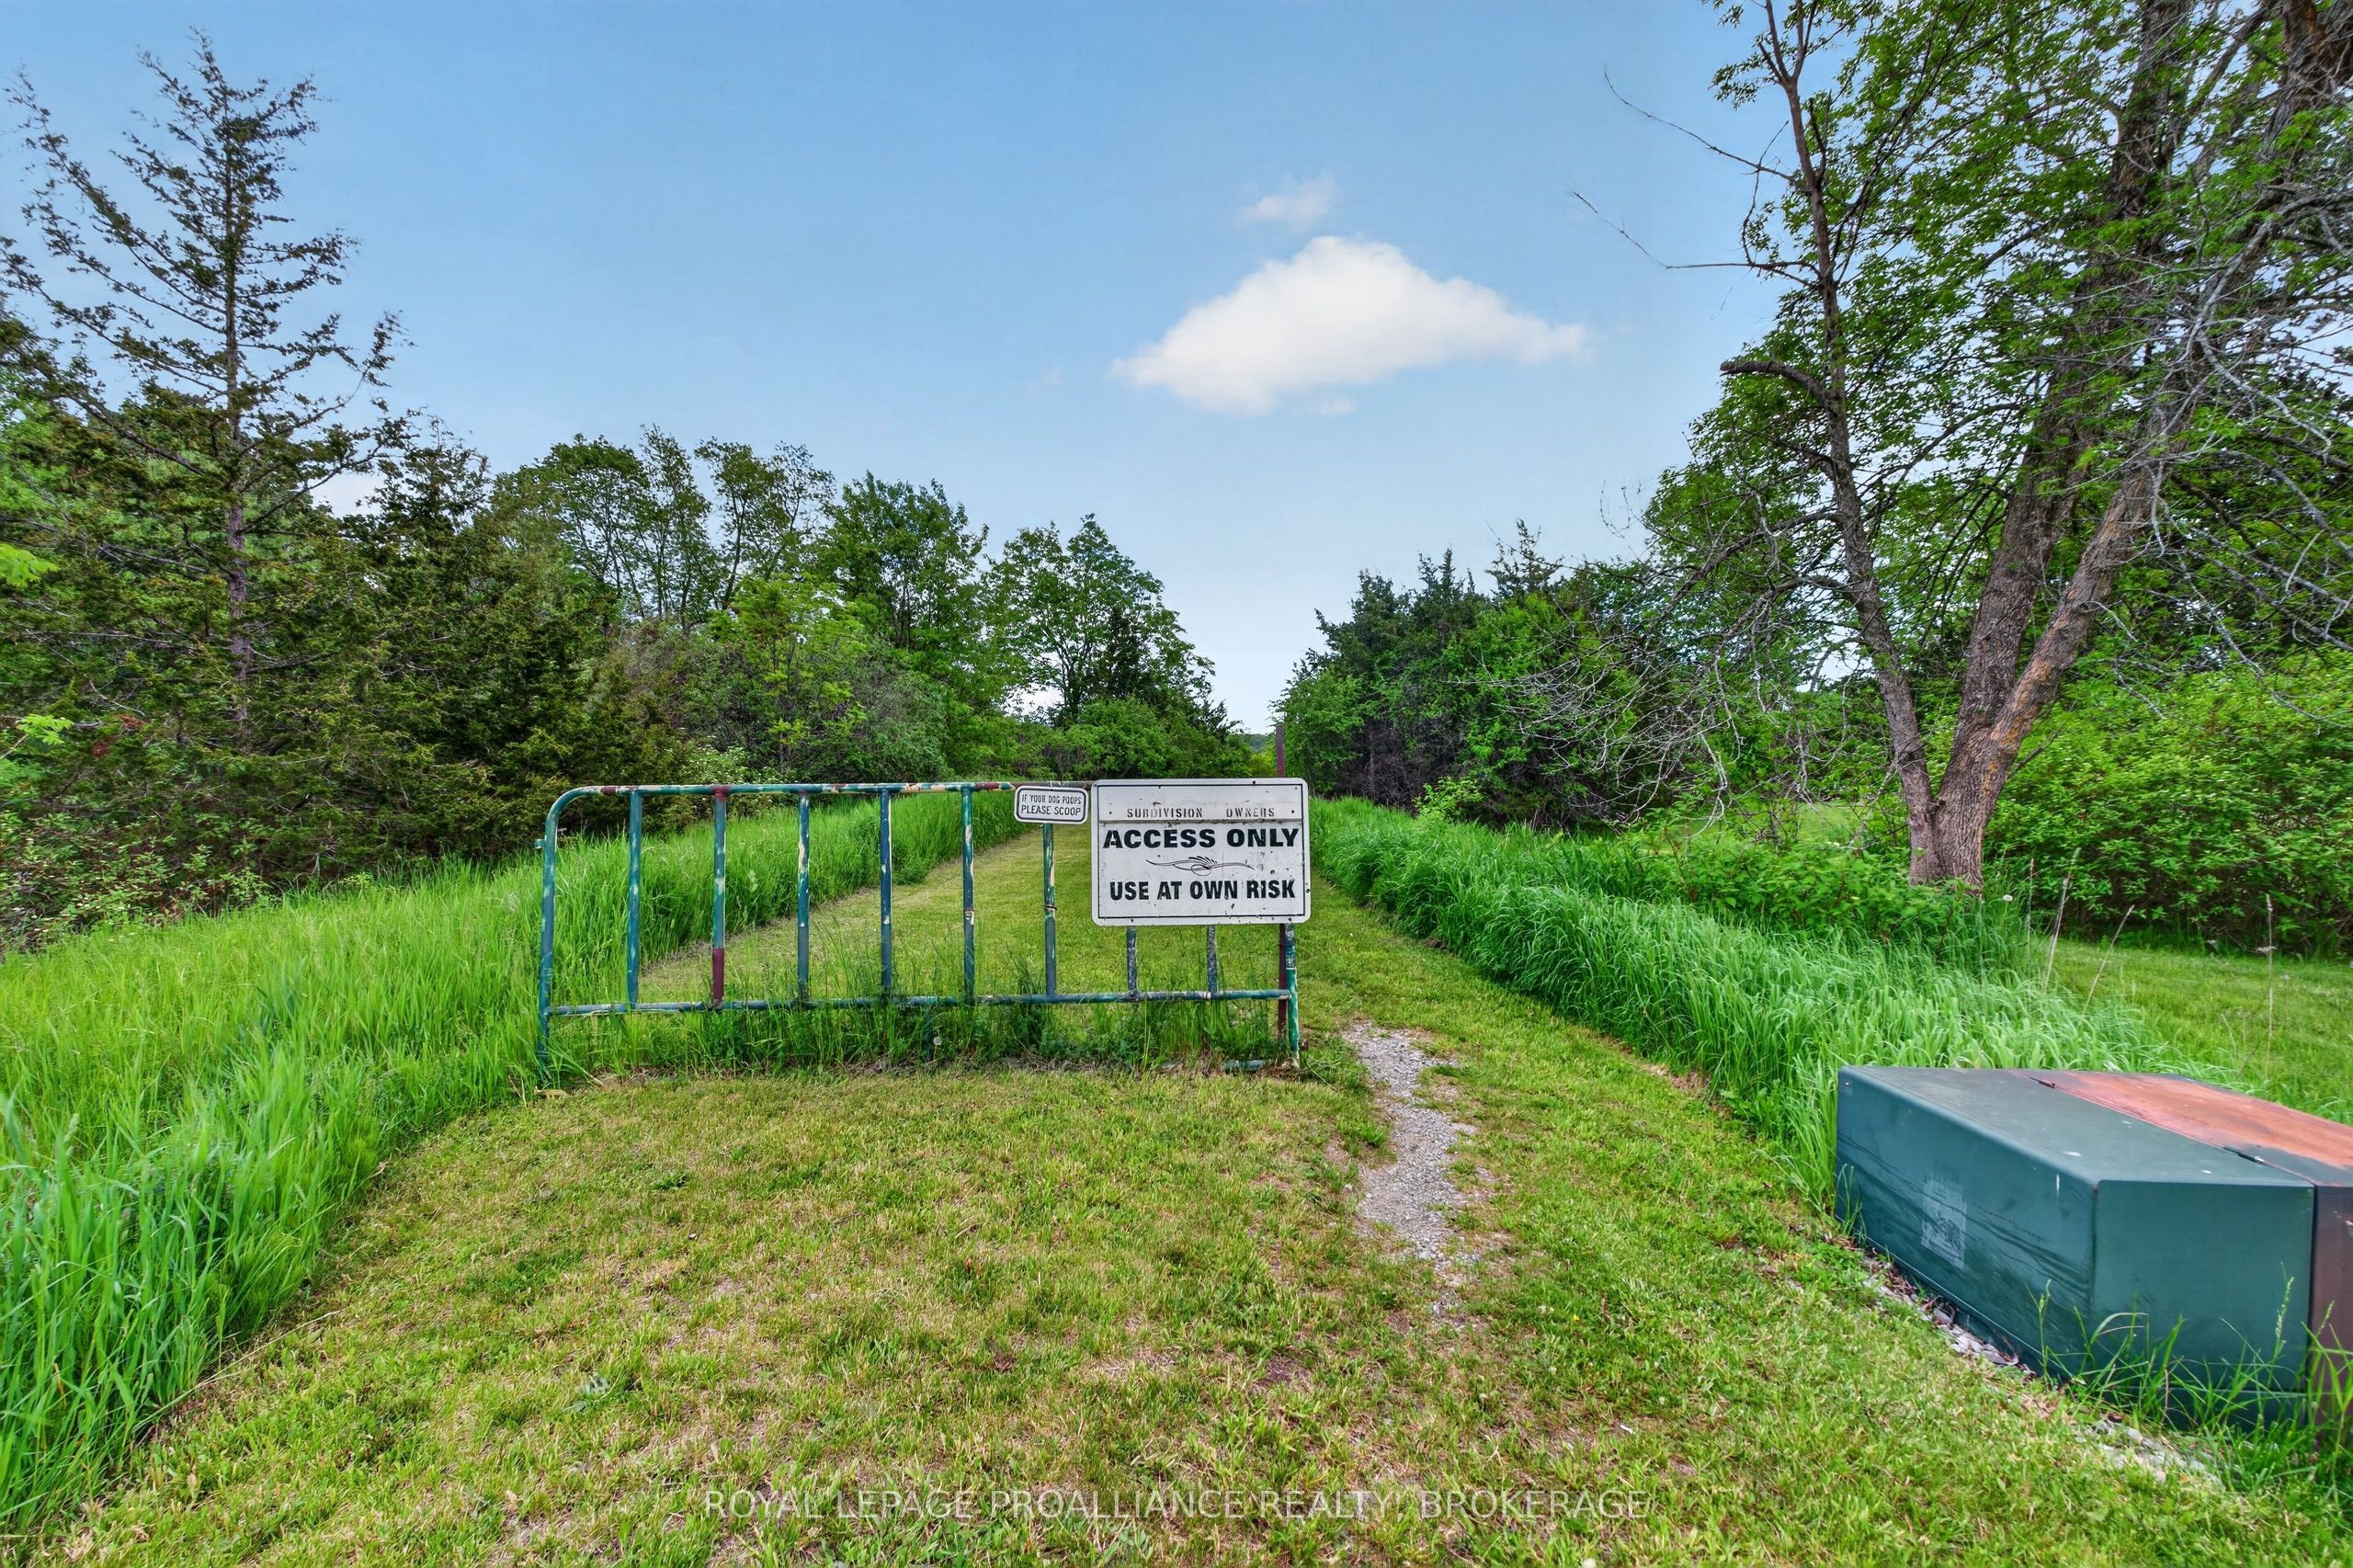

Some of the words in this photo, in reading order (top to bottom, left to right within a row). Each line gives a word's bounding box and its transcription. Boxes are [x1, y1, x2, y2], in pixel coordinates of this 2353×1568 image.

[1021, 794, 1028, 802] IF
[1029, 794, 1046, 803] YOUR
[1048, 795, 1060, 804] DOG
[1021, 804, 1051, 814] PLEASE
[1054, 806, 1082, 816] SCOOP
[1127, 807, 1203, 818] SUBDIVISION
[1226, 807, 1275, 818] OWNERS
[1103, 829, 1216, 848] ACCESS
[1226, 828, 1299, 847] ONLY
[1110, 881, 1149, 900] USE
[1156, 881, 1182, 900] AT
[1189, 880, 1238, 899] OWN
[1246, 880, 1296, 899] RISK
